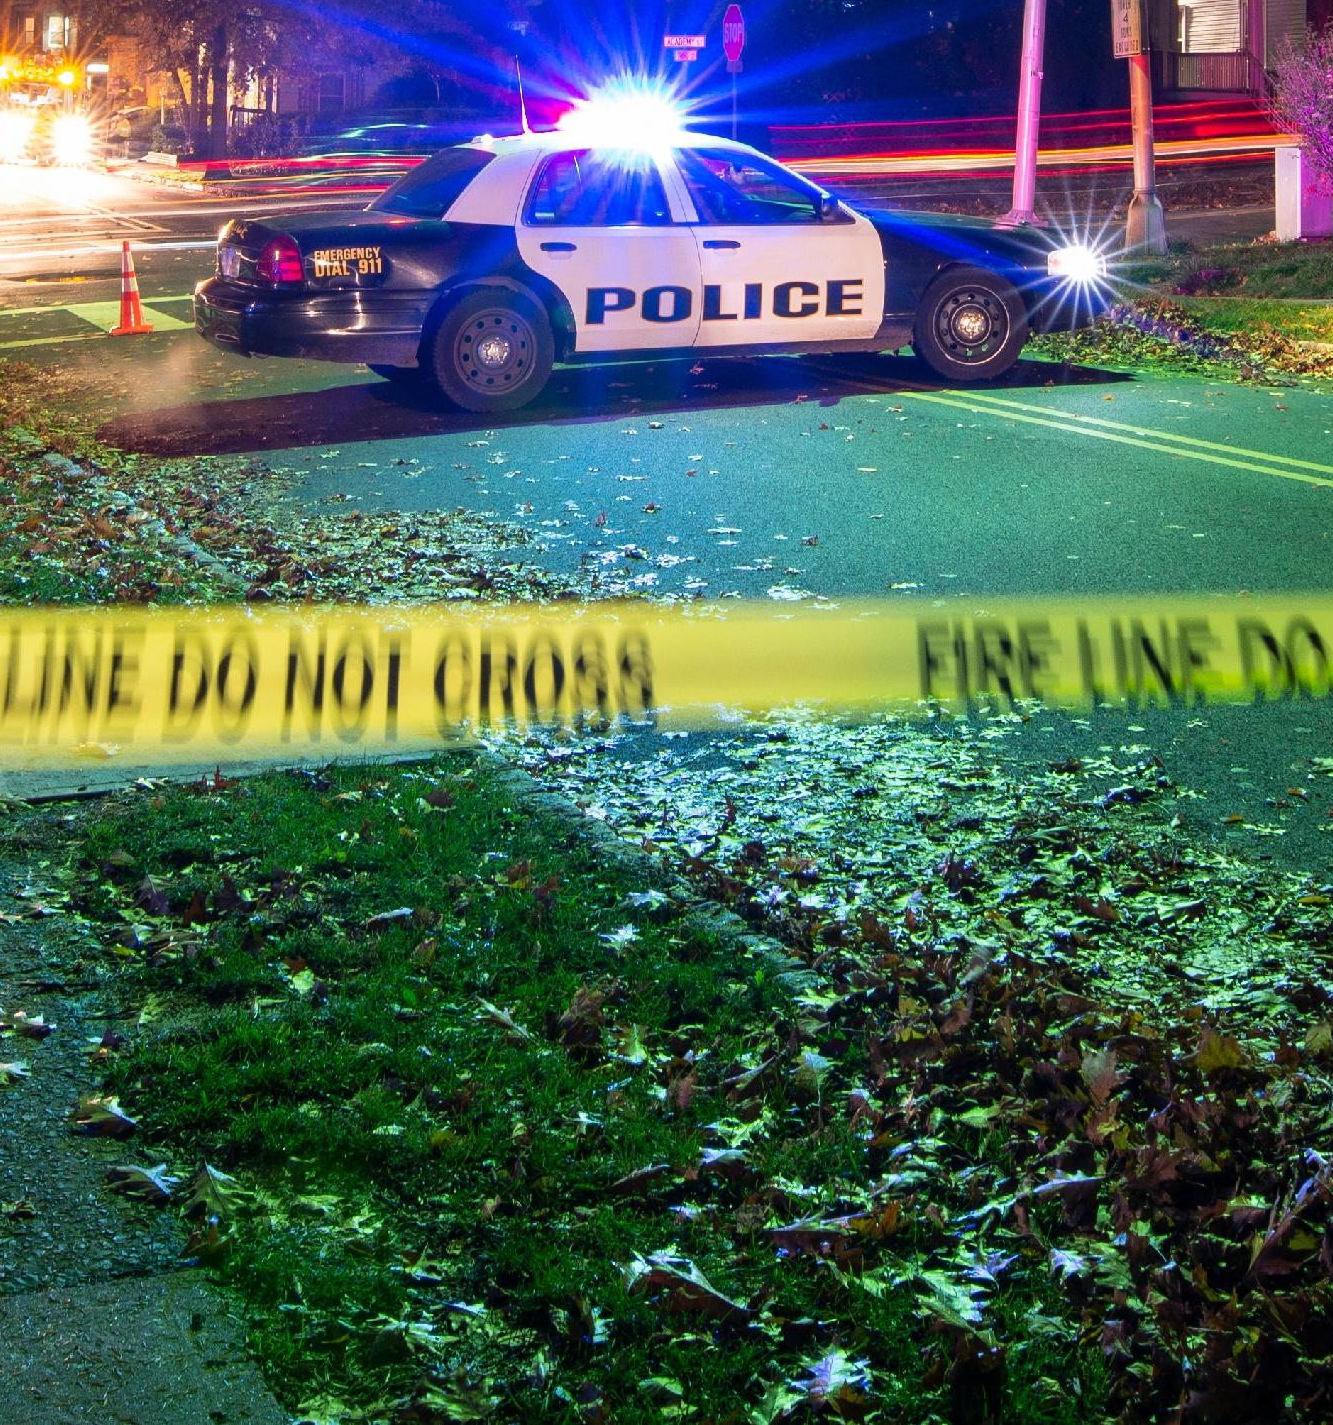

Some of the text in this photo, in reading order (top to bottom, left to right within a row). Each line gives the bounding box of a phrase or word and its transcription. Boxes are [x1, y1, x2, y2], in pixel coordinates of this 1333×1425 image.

[1123, 13, 1129, 23] 4
[725, 22, 742, 43] STOP
[314, 247, 381, 261] EMERGENCY
[315, 258, 382, 277] DIAL 911
[585, 279, 864, 326] POLICE
[917, 618, 1060, 703] FIRE
[1078, 617, 1223, 705] LINE
[1238, 615, 1332, 697] DO
[164, 631, 258, 743] DO
[281, 628, 412, 742] NOT
